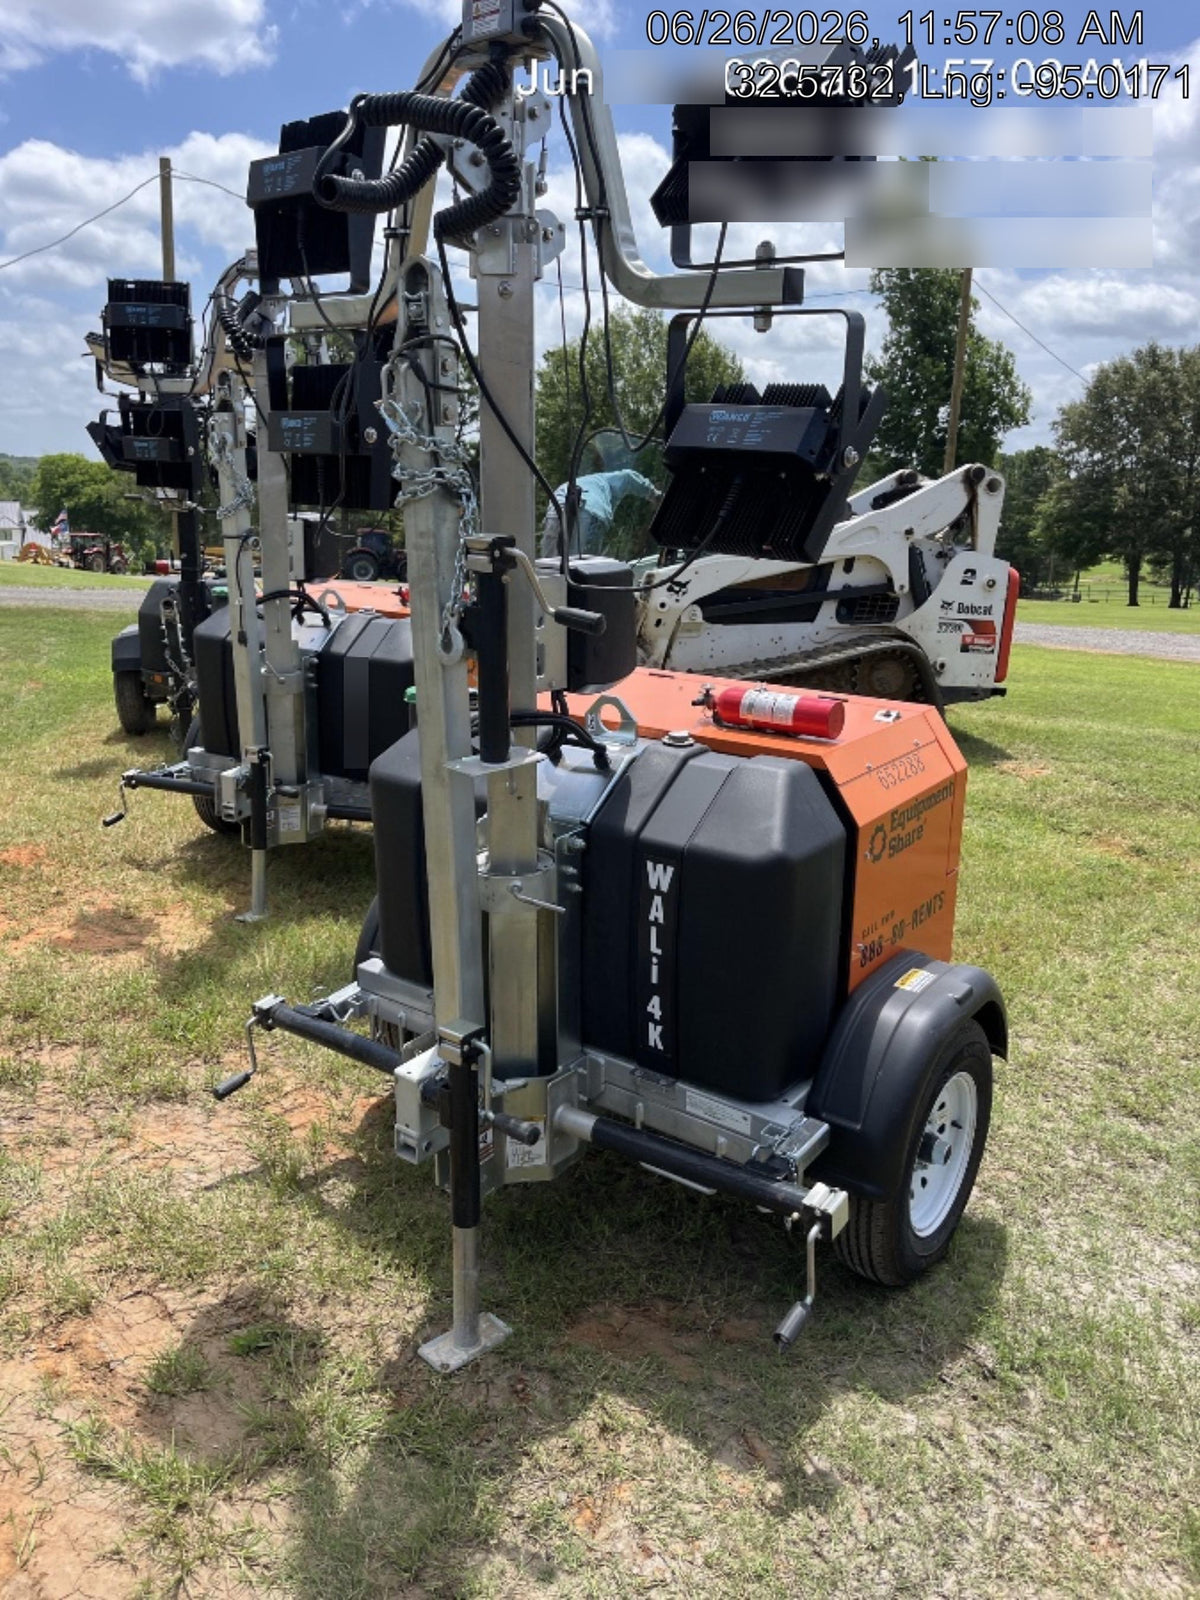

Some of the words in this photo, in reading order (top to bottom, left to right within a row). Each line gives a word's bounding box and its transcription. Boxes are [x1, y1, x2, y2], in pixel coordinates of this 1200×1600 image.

[960, 568, 977, 586] 2
[957, 602, 993, 616] Bobcat
[876, 752, 926, 790] 652288
[890, 779, 954, 832] Equipment
[889, 824, 924, 859] Share
